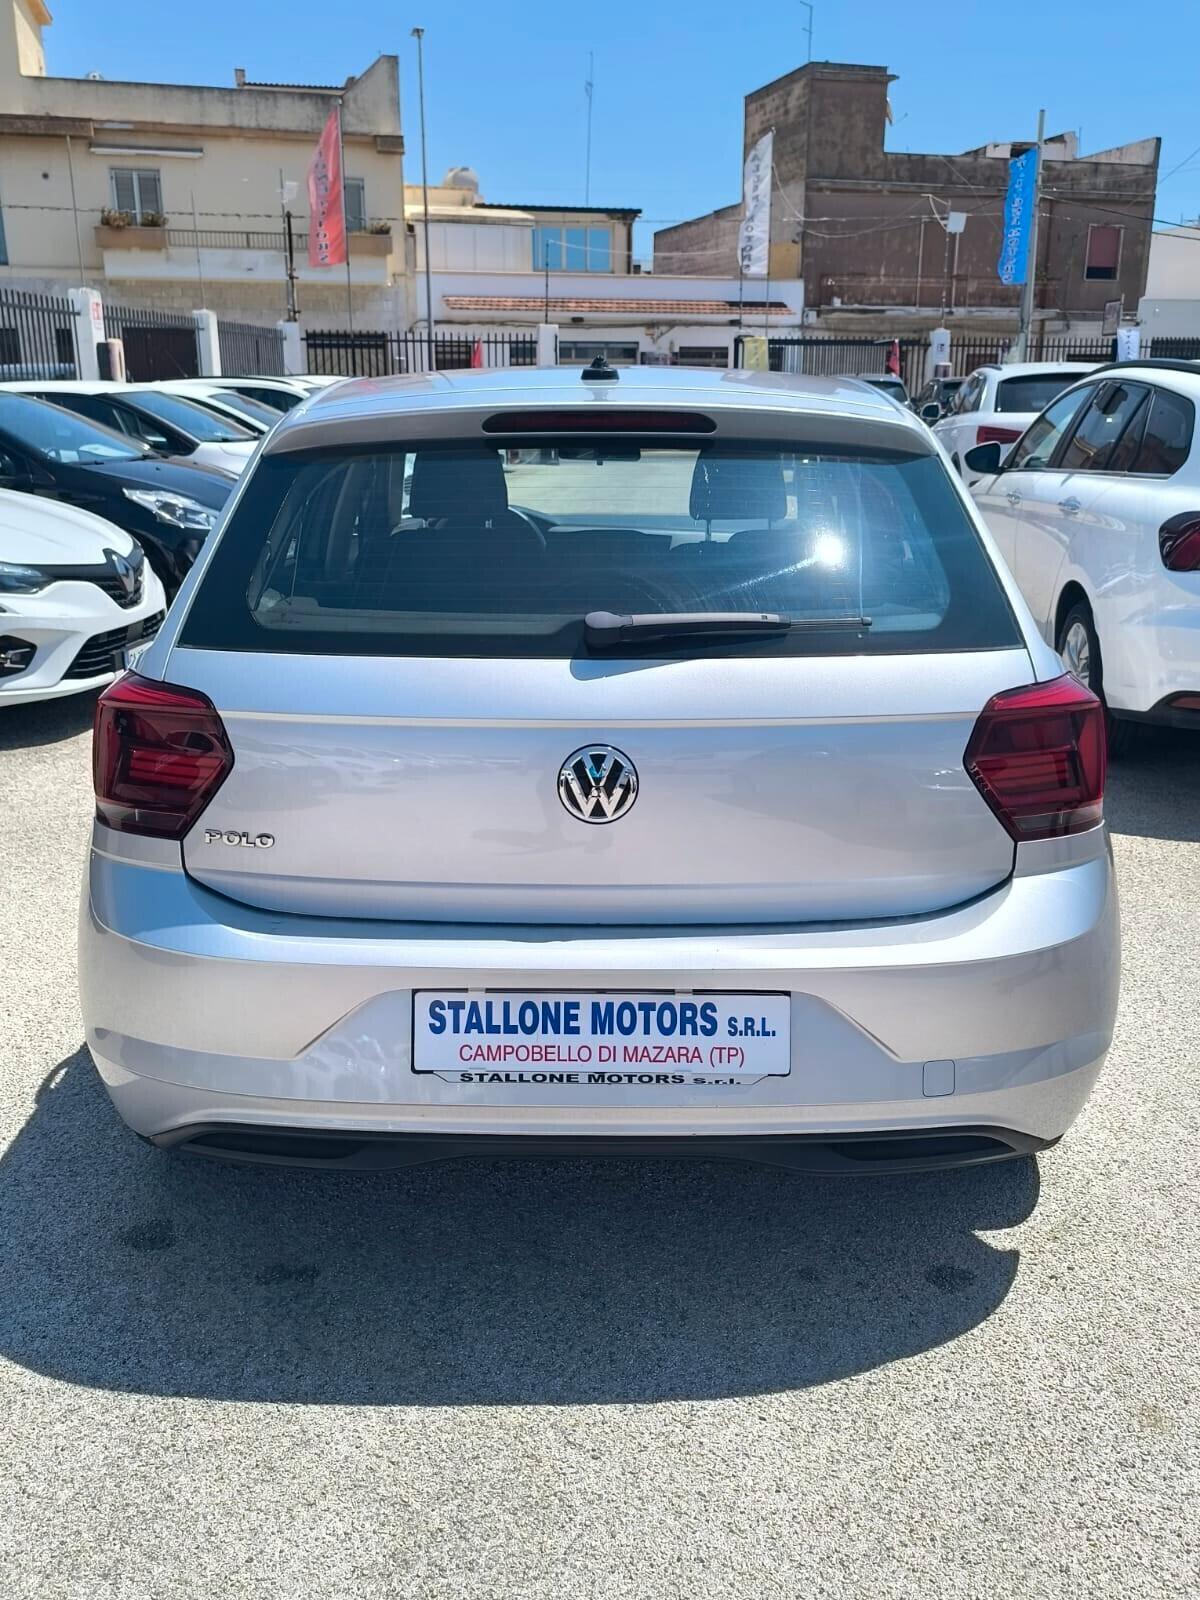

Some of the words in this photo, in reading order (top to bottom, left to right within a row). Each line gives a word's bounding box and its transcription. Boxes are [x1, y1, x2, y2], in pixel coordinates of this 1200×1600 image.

[204, 829, 275, 849] POLO
[428, 999, 581, 1036] STALLONE
[591, 1001, 718, 1037] MOTORS
[727, 1016, 777, 1037] S.R.L.
[459, 1044, 592, 1063] CAMPOBELLO
[598, 1045, 617, 1063] DI
[623, 1046, 703, 1064] MAZARA
[709, 1046, 745, 1068] (TP)
[460, 1073, 580, 1083] STALLONE
[588, 1073, 685, 1085] MOTORS
